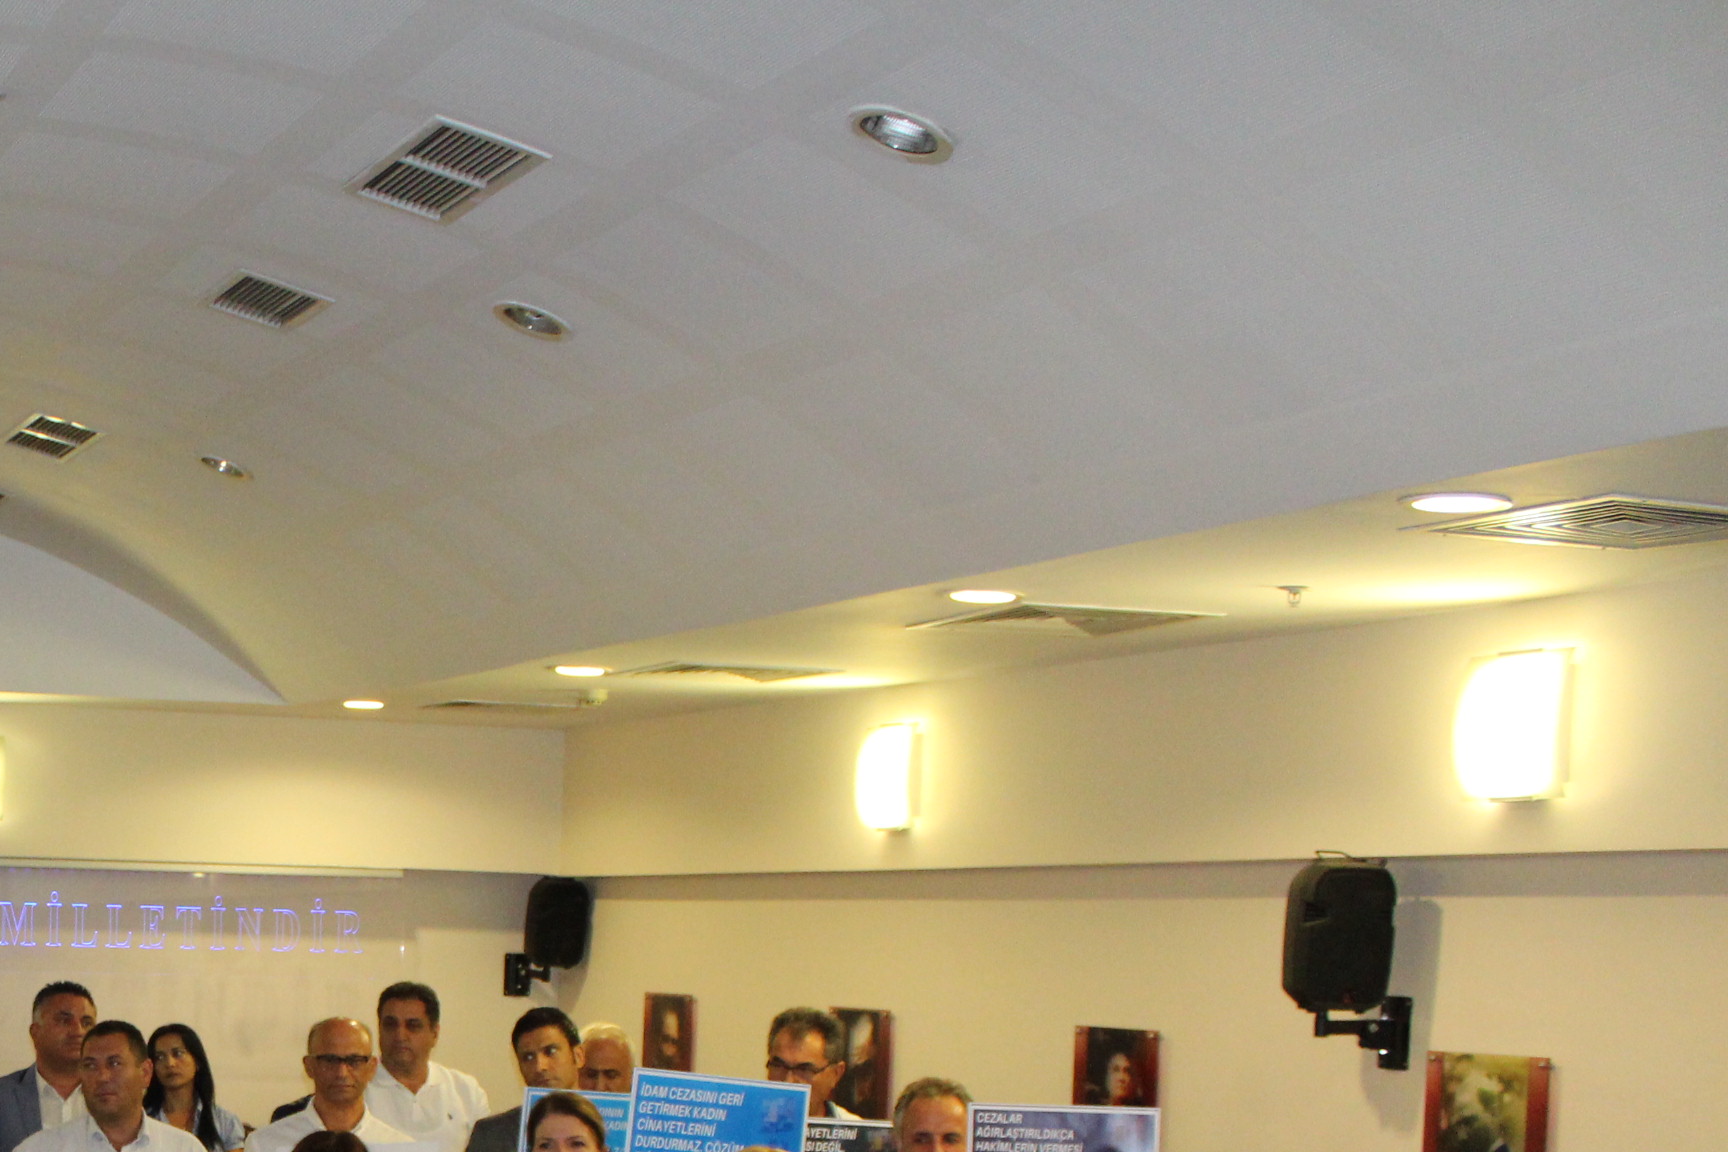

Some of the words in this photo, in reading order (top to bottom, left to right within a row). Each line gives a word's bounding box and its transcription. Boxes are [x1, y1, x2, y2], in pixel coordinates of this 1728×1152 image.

[641, 1084, 669, 1098] İDAM
[669, 1088, 717, 1104] CEZASINI
[719, 1092, 745, 1107] GERİ
[639, 1100, 696, 1118] GETİRMEK
[693, 1107, 727, 1121] KADIN
[976, 1112, 1023, 1124] CEZALAR
[637, 1117, 717, 1137] CİNAYETLERİNİ
[976, 1126, 1075, 1141] AĞIRLAŞTIRILDIKÇA
[975, 1140, 1037, 1152] HAKİMLERİN
